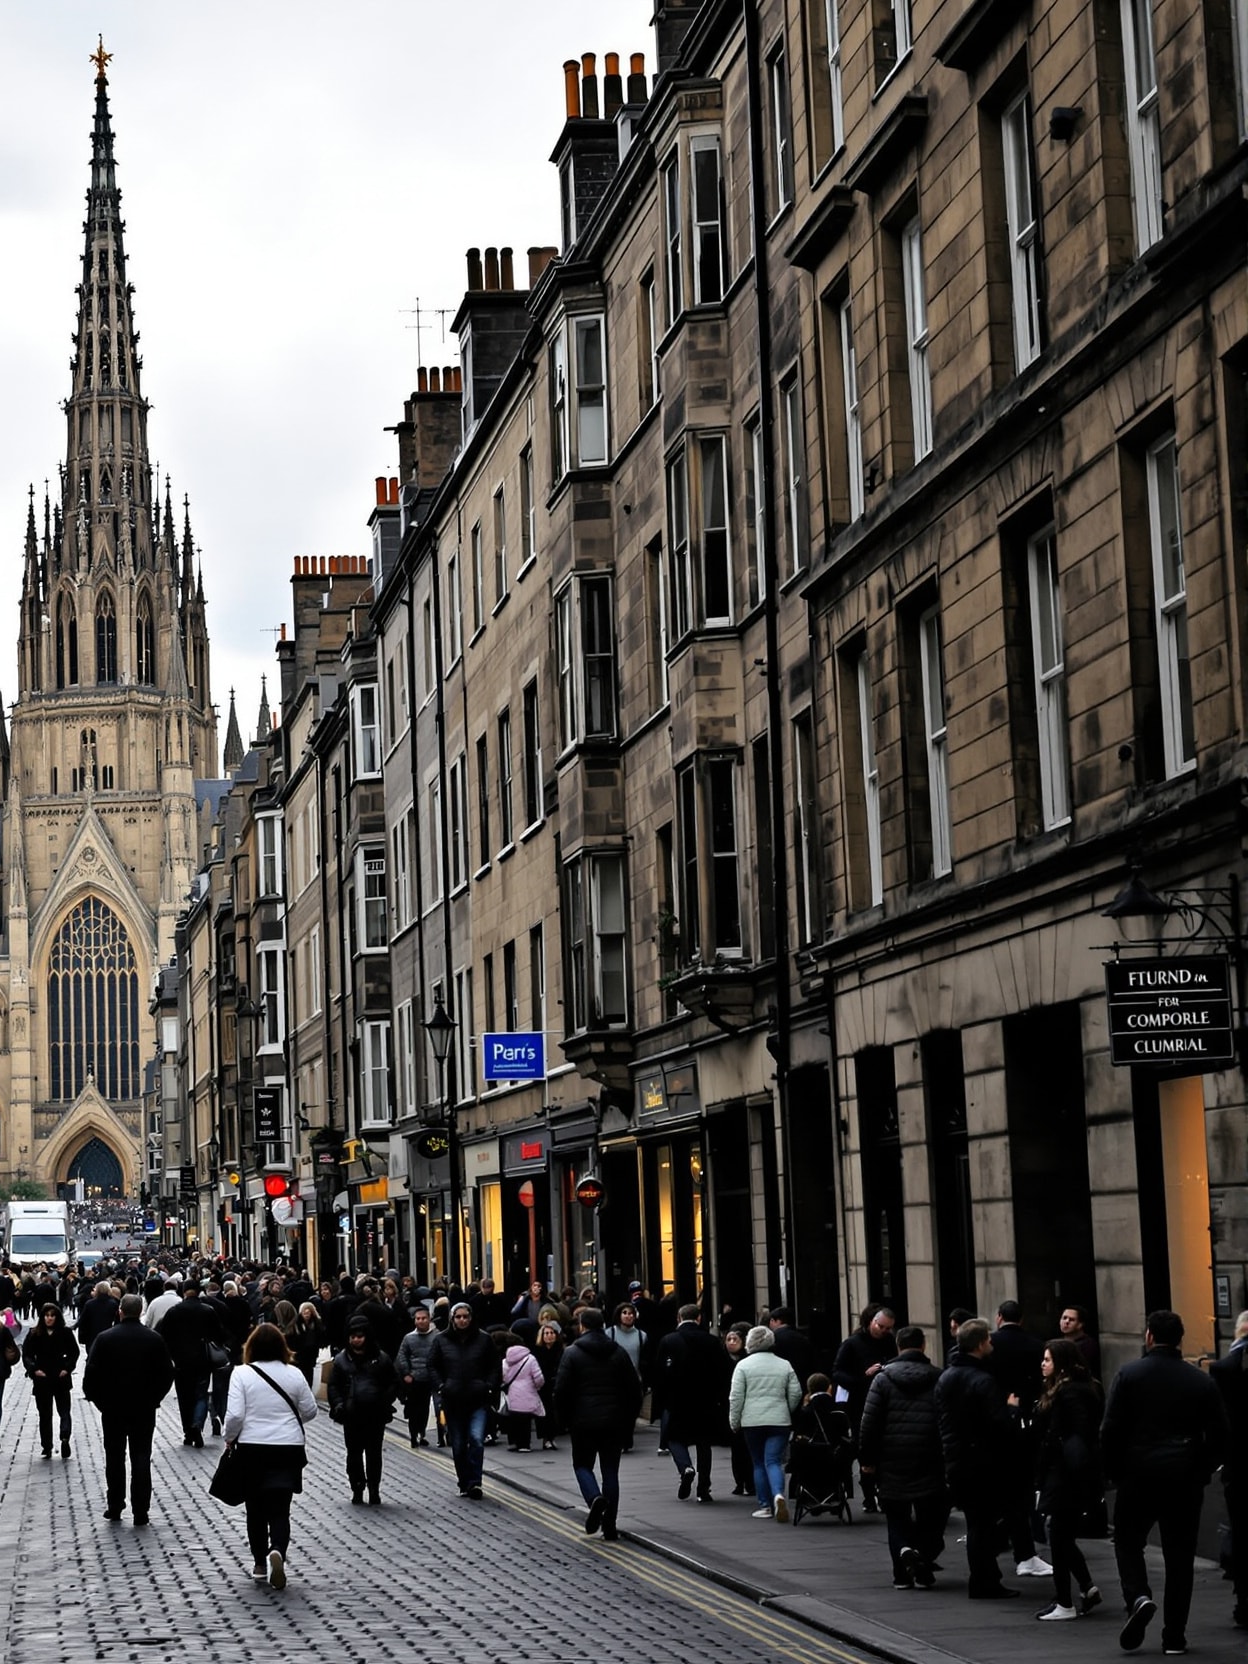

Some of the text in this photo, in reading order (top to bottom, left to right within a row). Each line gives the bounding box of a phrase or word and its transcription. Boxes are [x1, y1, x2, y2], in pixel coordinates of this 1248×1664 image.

[1128, 969, 1192, 987] FTURND
[1127, 1011, 1211, 1029] COMPORLE
[1134, 1038, 1208, 1054] CLUMRIAL
